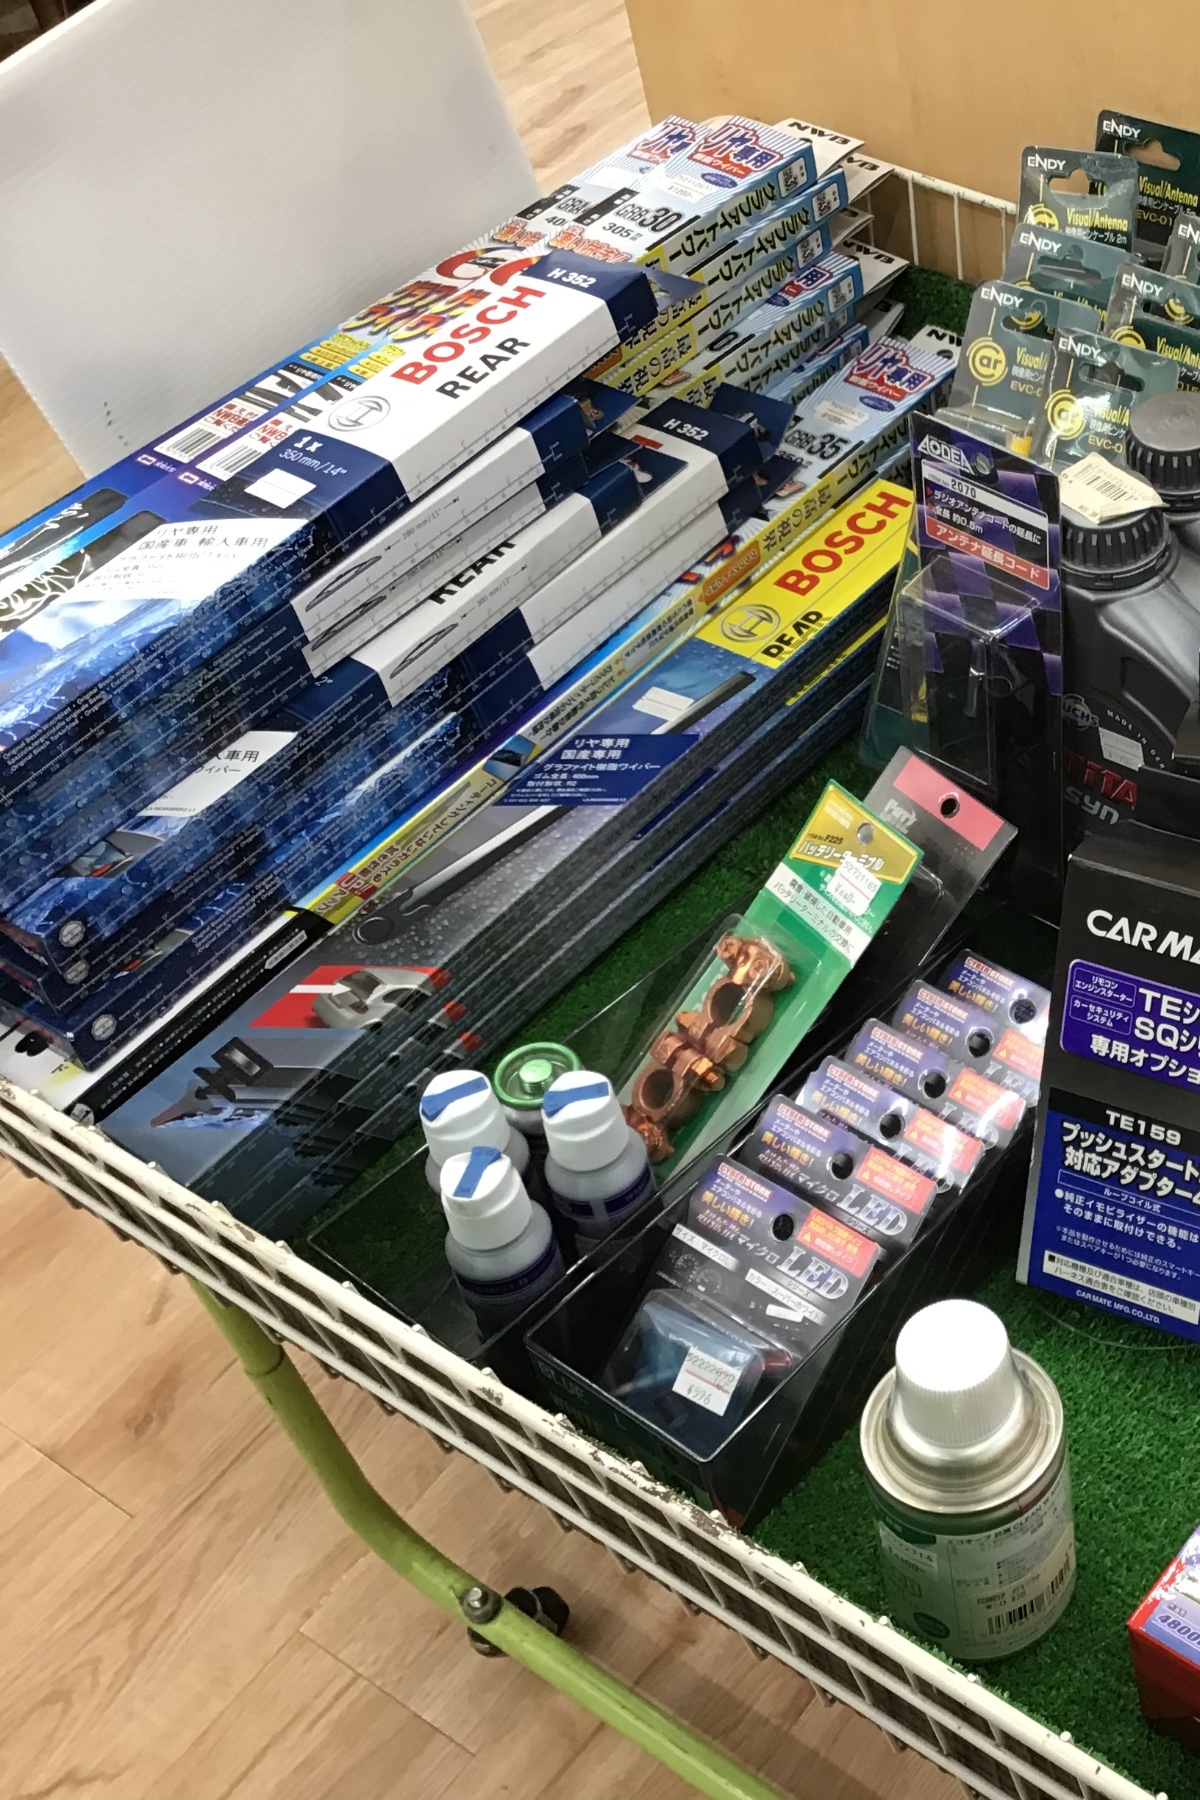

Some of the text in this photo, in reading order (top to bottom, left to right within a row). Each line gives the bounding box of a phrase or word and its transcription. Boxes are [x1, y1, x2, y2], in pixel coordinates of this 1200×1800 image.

[790, 121, 851, 145] NWB
[1102, 118, 1142, 139] ENDY
[1027, 153, 1067, 171] ENDY
[1138, 174, 1200, 208] Visual/Antenna
[1066, 207, 1129, 232] Visual/Antenna
[1019, 230, 1063, 254] ENDY
[547, 268, 598, 288] H 352
[1121, 272, 1164, 298] ENDY
[981, 285, 1024, 308] ENDY
[390, 285, 548, 386] BOSCH
[1058, 336, 1102, 359] ENDY
[436, 336, 531, 401] REAR
[663, 418, 709, 441] H 352
[950, 478, 978, 500] 2070
[934, 490, 1042, 545] ラジオアンテナコードの延長に
[934, 505, 984, 535] 全長 約0.5m
[774, 491, 913, 597] BOSCH
[936, 524, 1041, 581] アンテナ延長コード
[1062, 702, 1099, 727] UCHS
[560, 749, 622, 760] 国産専用
[574, 737, 630, 749] リヤ専用
[773, 880, 856, 954] バッテリーターミナルの交換に
[1074, 980, 1134, 1003] エンジンスターター
[1091, 975, 1119, 989] リモコン
[1072, 999, 1131, 1023] カーセキュリティ
[1085, 1013, 1115, 1028] システム
[1105, 1109, 1183, 1146] TE159
[797, 1173, 840, 1203] マイクロ
[836, 1183, 909, 1237] LED
[1103, 1187, 1162, 1214] ループコイル式
[1063, 1203, 1183, 1252] そのままに取付けできる。
[736, 1232, 850, 1300] マイクロ LED
